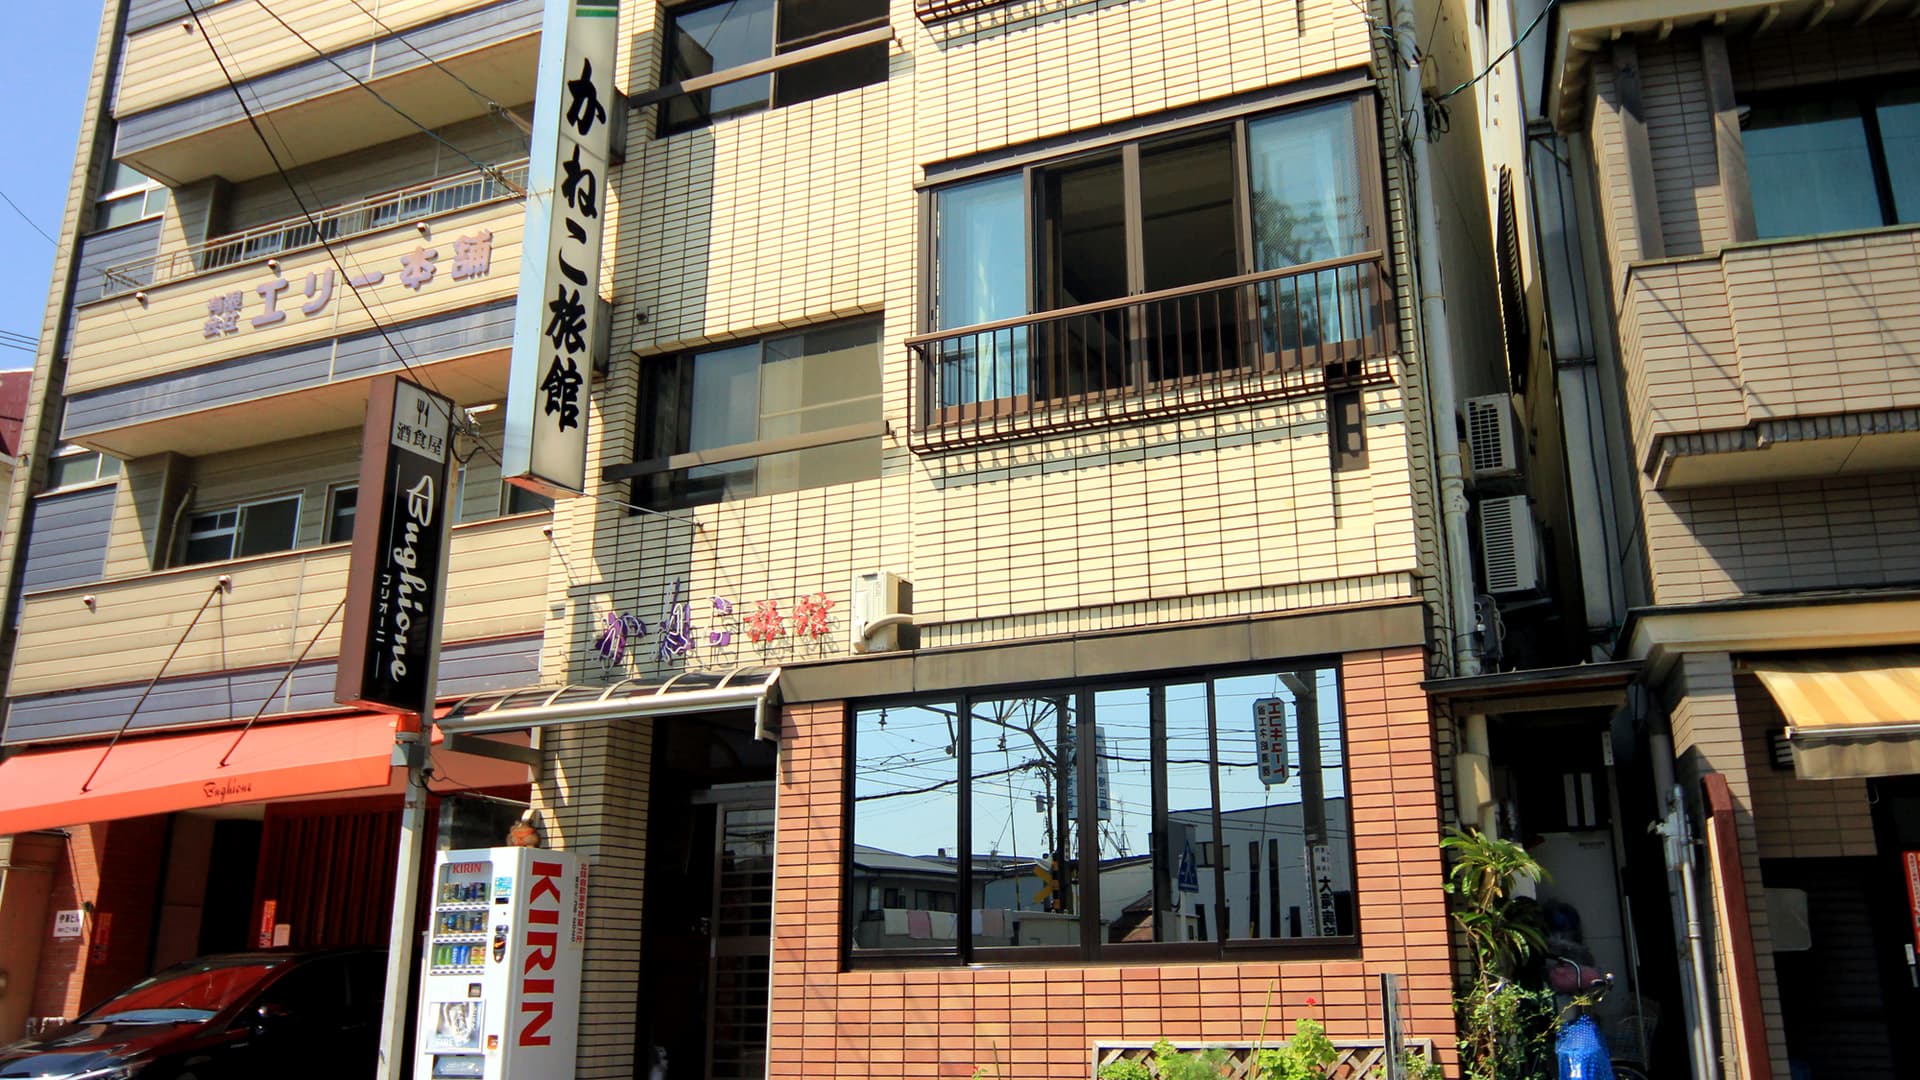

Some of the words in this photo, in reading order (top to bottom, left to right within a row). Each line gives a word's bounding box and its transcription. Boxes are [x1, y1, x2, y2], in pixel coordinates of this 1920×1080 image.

[252, 228, 493, 327] エリー本舗
[540, 58, 607, 432] かねこ旅館
[397, 421, 442, 456] 酒食屋
[390, 475, 434, 682] Bughione
[452, 863, 482, 875] KIRIN
[519, 861, 563, 1047] KIRIN
